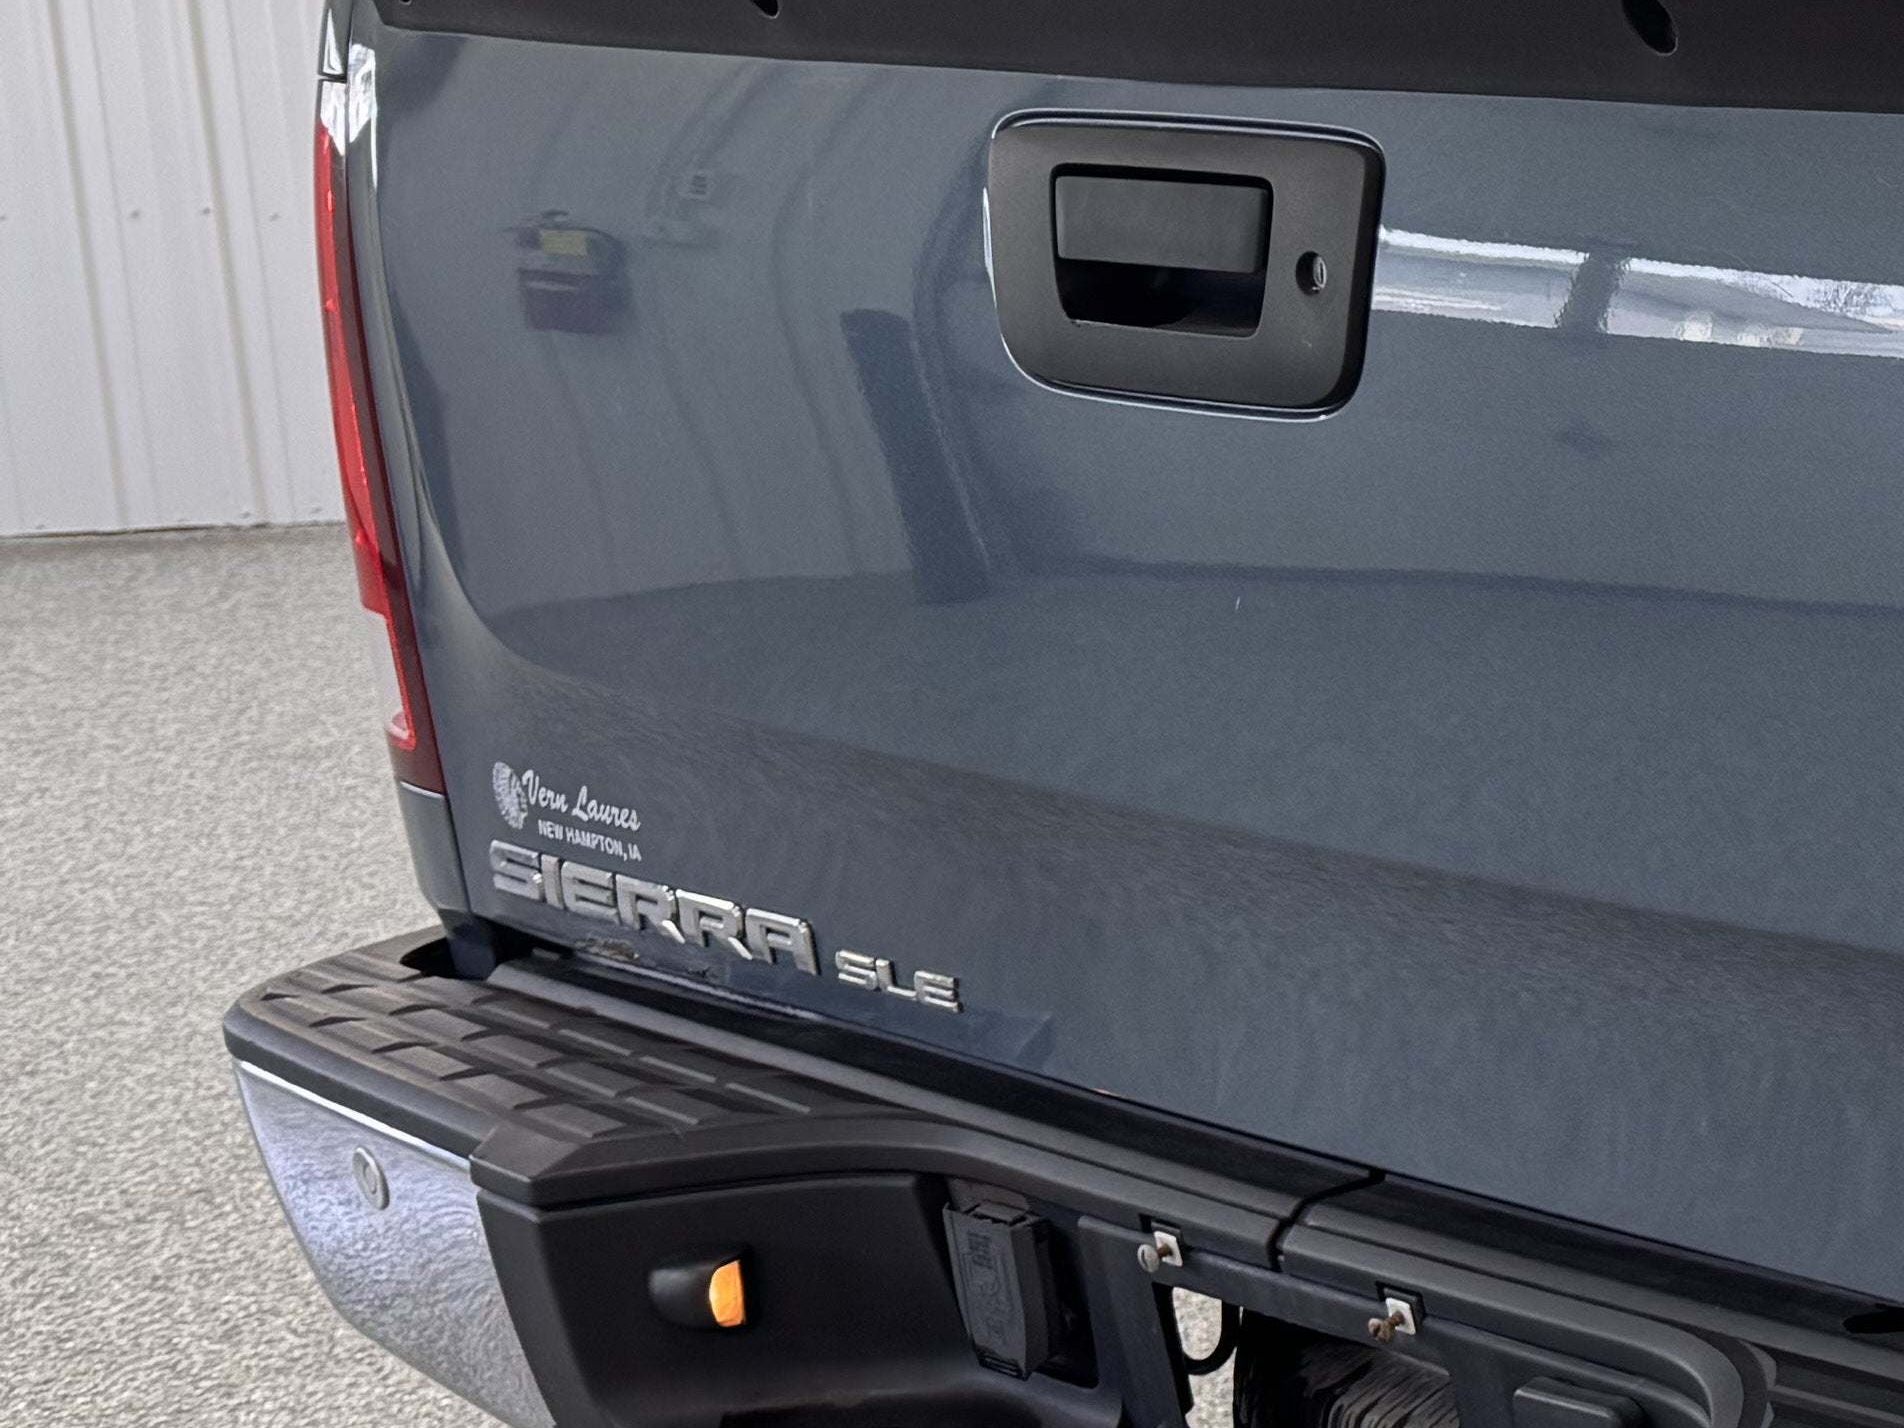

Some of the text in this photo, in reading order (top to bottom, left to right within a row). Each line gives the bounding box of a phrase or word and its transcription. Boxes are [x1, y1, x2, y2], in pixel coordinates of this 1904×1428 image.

[522, 769, 641, 831] Vern Laures
[538, 819, 564, 841] NEW
[489, 839, 962, 1012] SIERRA SLE
